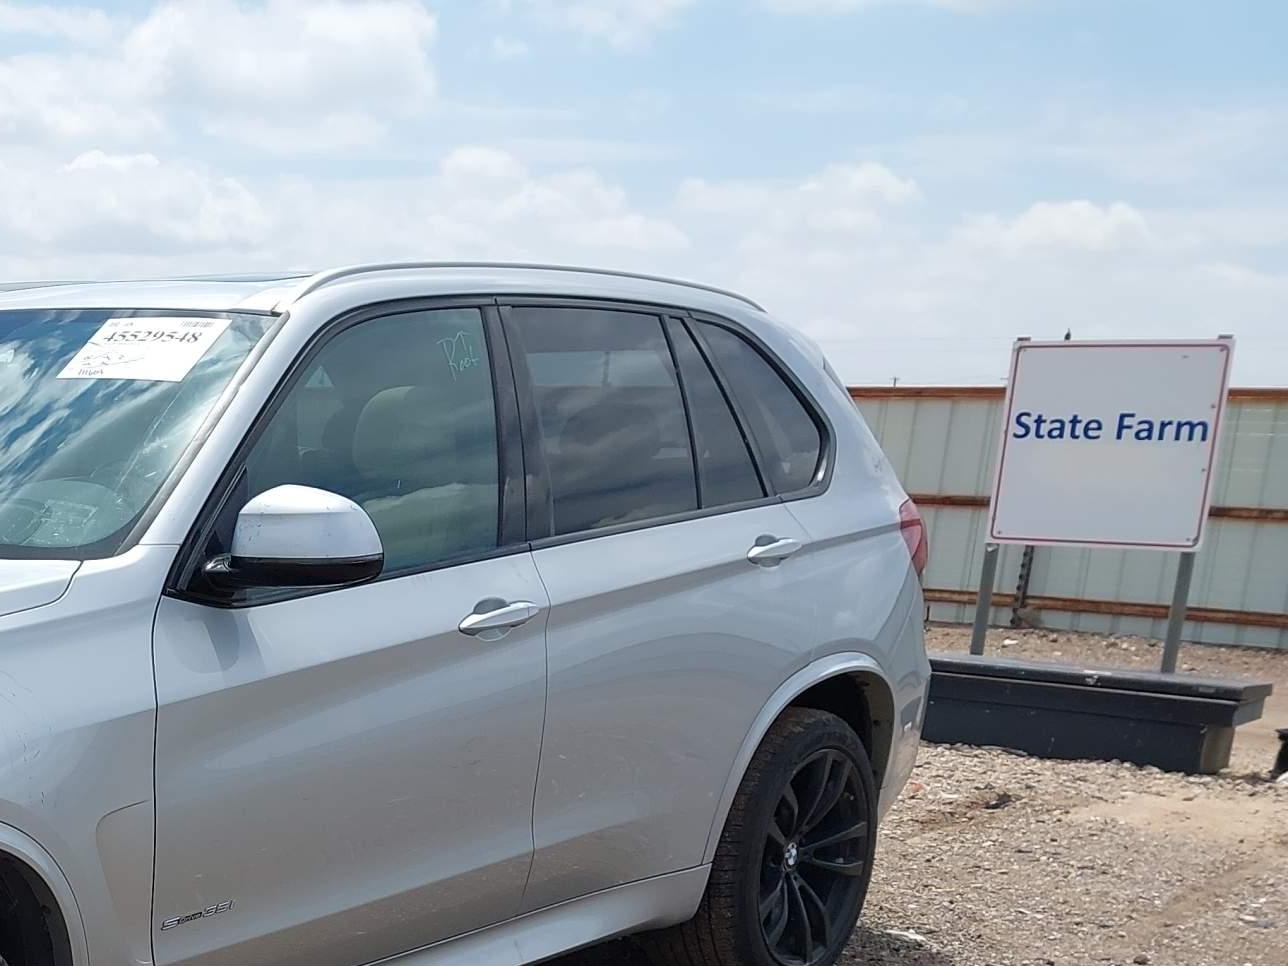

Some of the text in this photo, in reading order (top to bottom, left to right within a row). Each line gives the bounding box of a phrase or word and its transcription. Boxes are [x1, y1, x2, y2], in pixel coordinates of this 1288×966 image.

[103, 330, 203, 343] 45529548
[1013, 411, 1209, 442] State Farm
